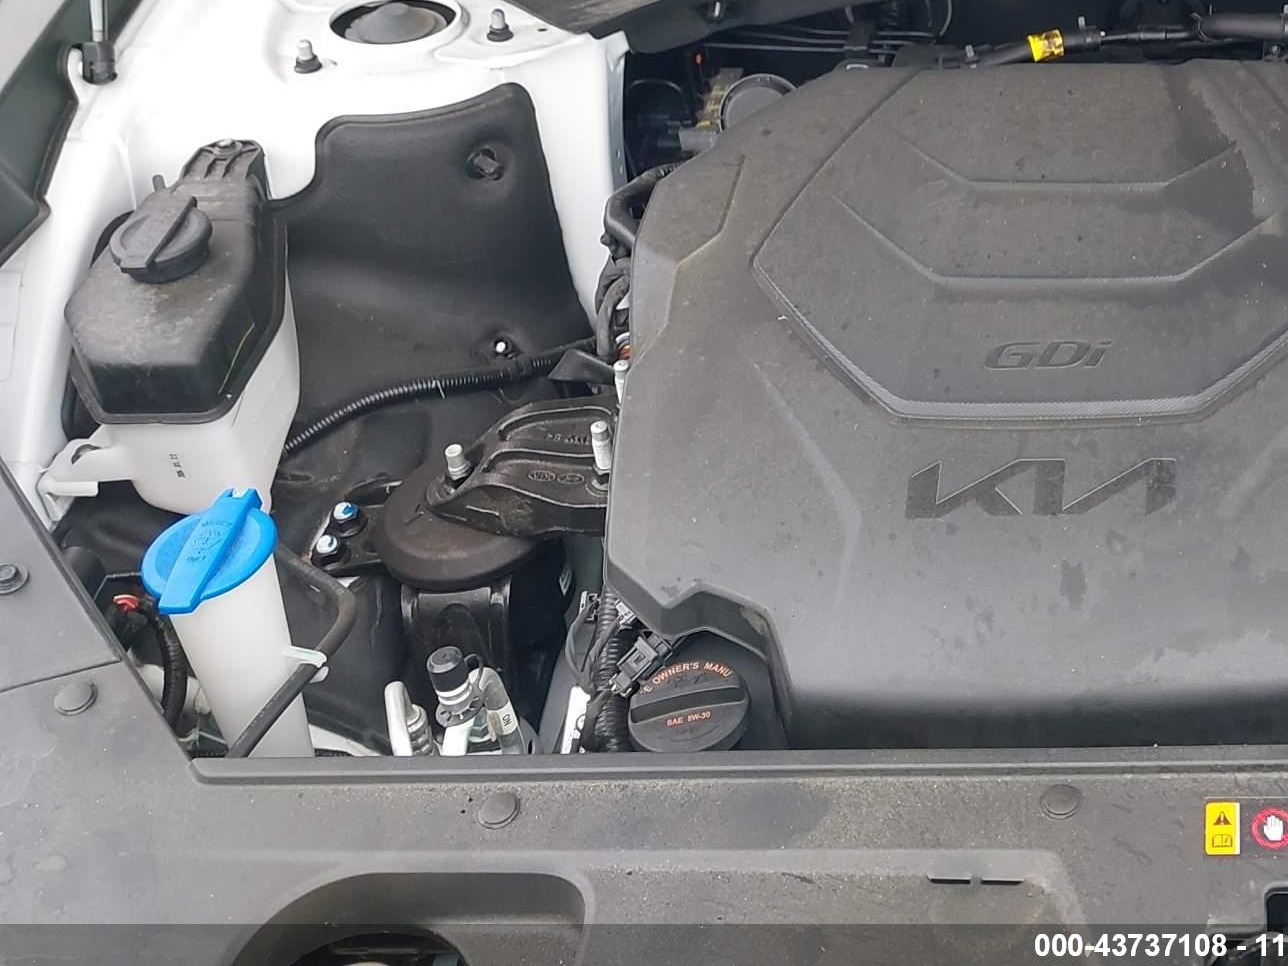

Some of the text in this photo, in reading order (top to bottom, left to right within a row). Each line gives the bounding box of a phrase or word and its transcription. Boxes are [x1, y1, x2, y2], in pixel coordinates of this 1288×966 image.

[984, 340, 1113, 371] GDi
[906, 458, 1177, 521] KIA
[652, 661, 701, 686] OWNER'S
[666, 710, 712, 727] SAE 5W-30
